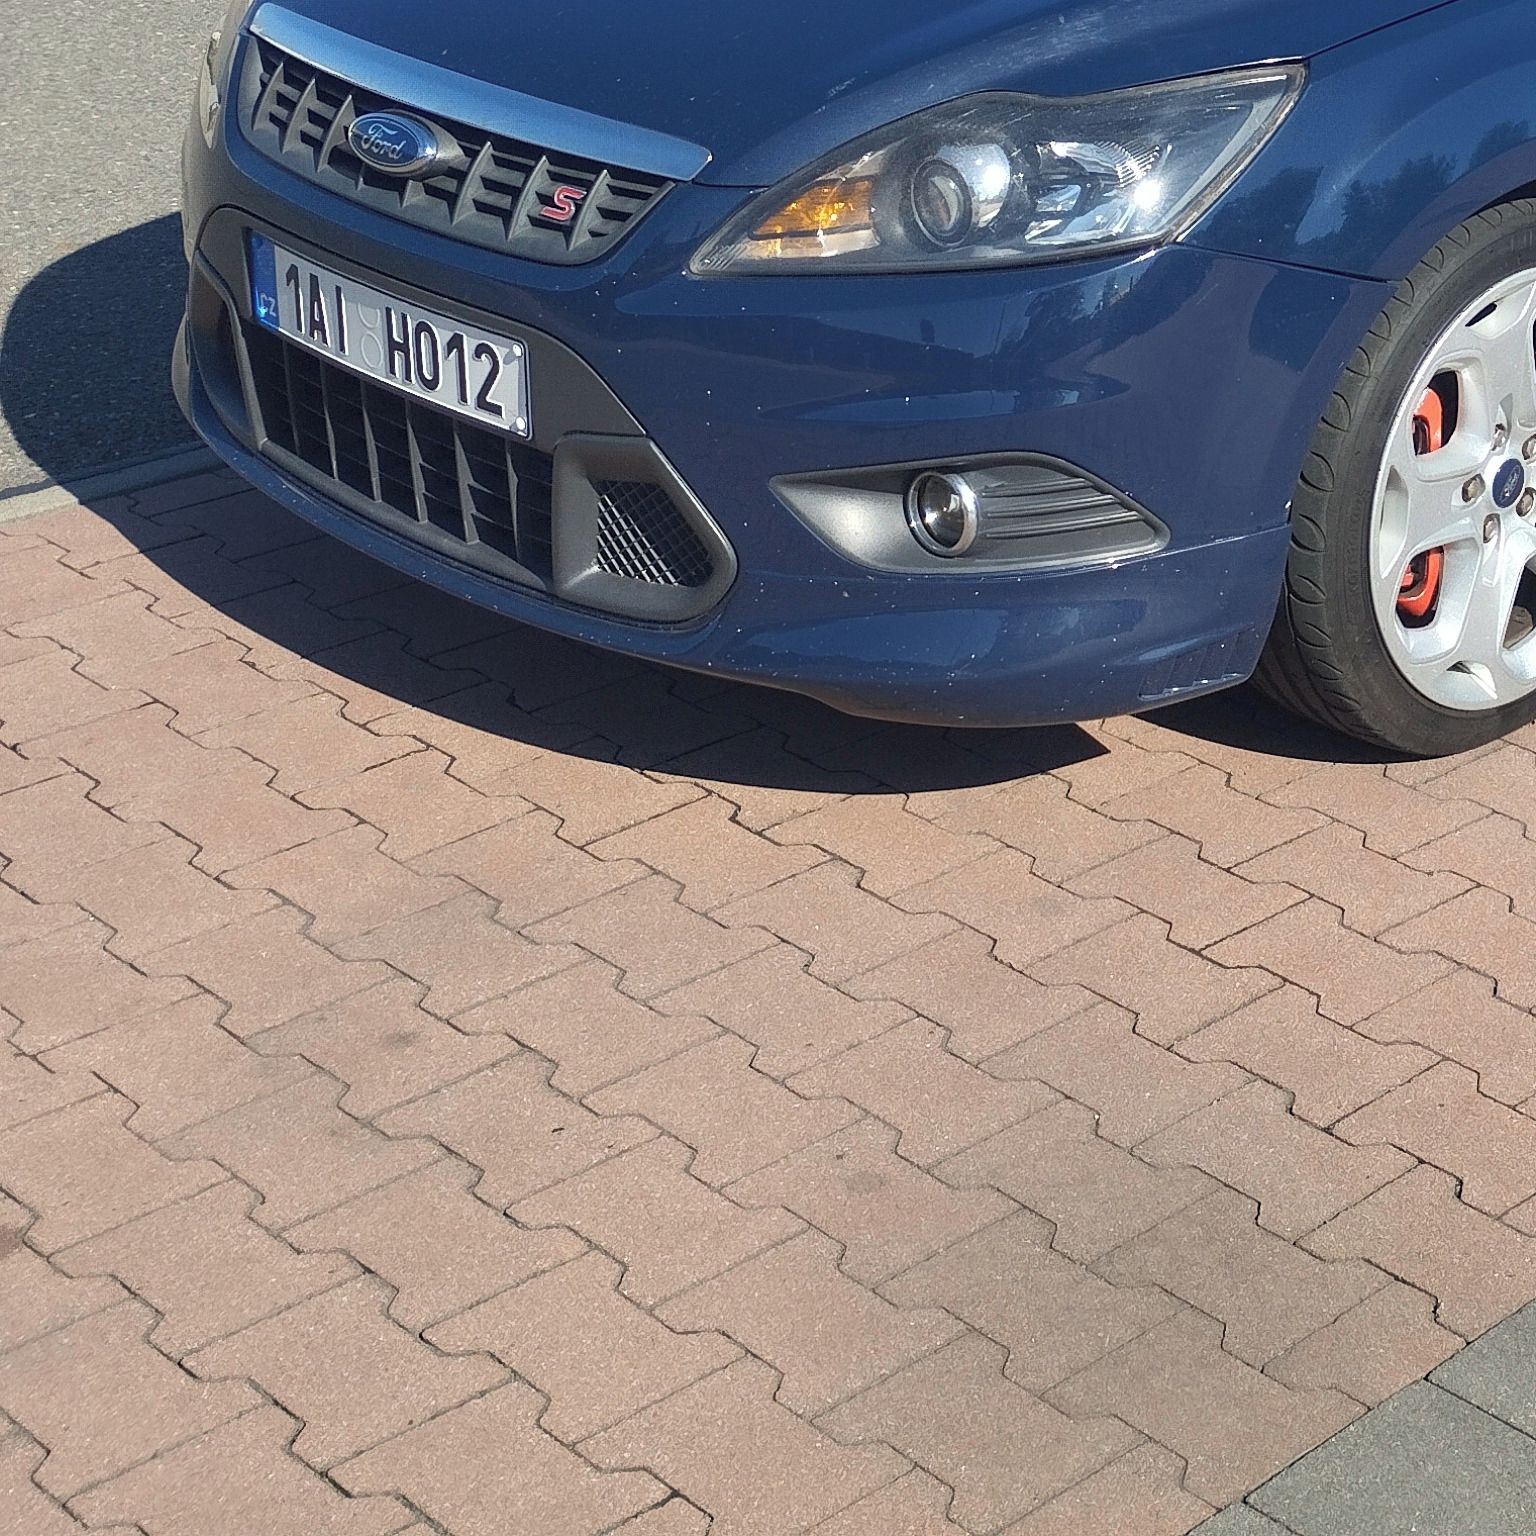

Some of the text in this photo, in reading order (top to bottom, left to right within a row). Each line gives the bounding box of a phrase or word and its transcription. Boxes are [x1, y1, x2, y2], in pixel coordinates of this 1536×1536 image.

[360, 122, 407, 160] Ford
[540, 185, 588, 222] S
[286, 263, 505, 419] 1AI H012
